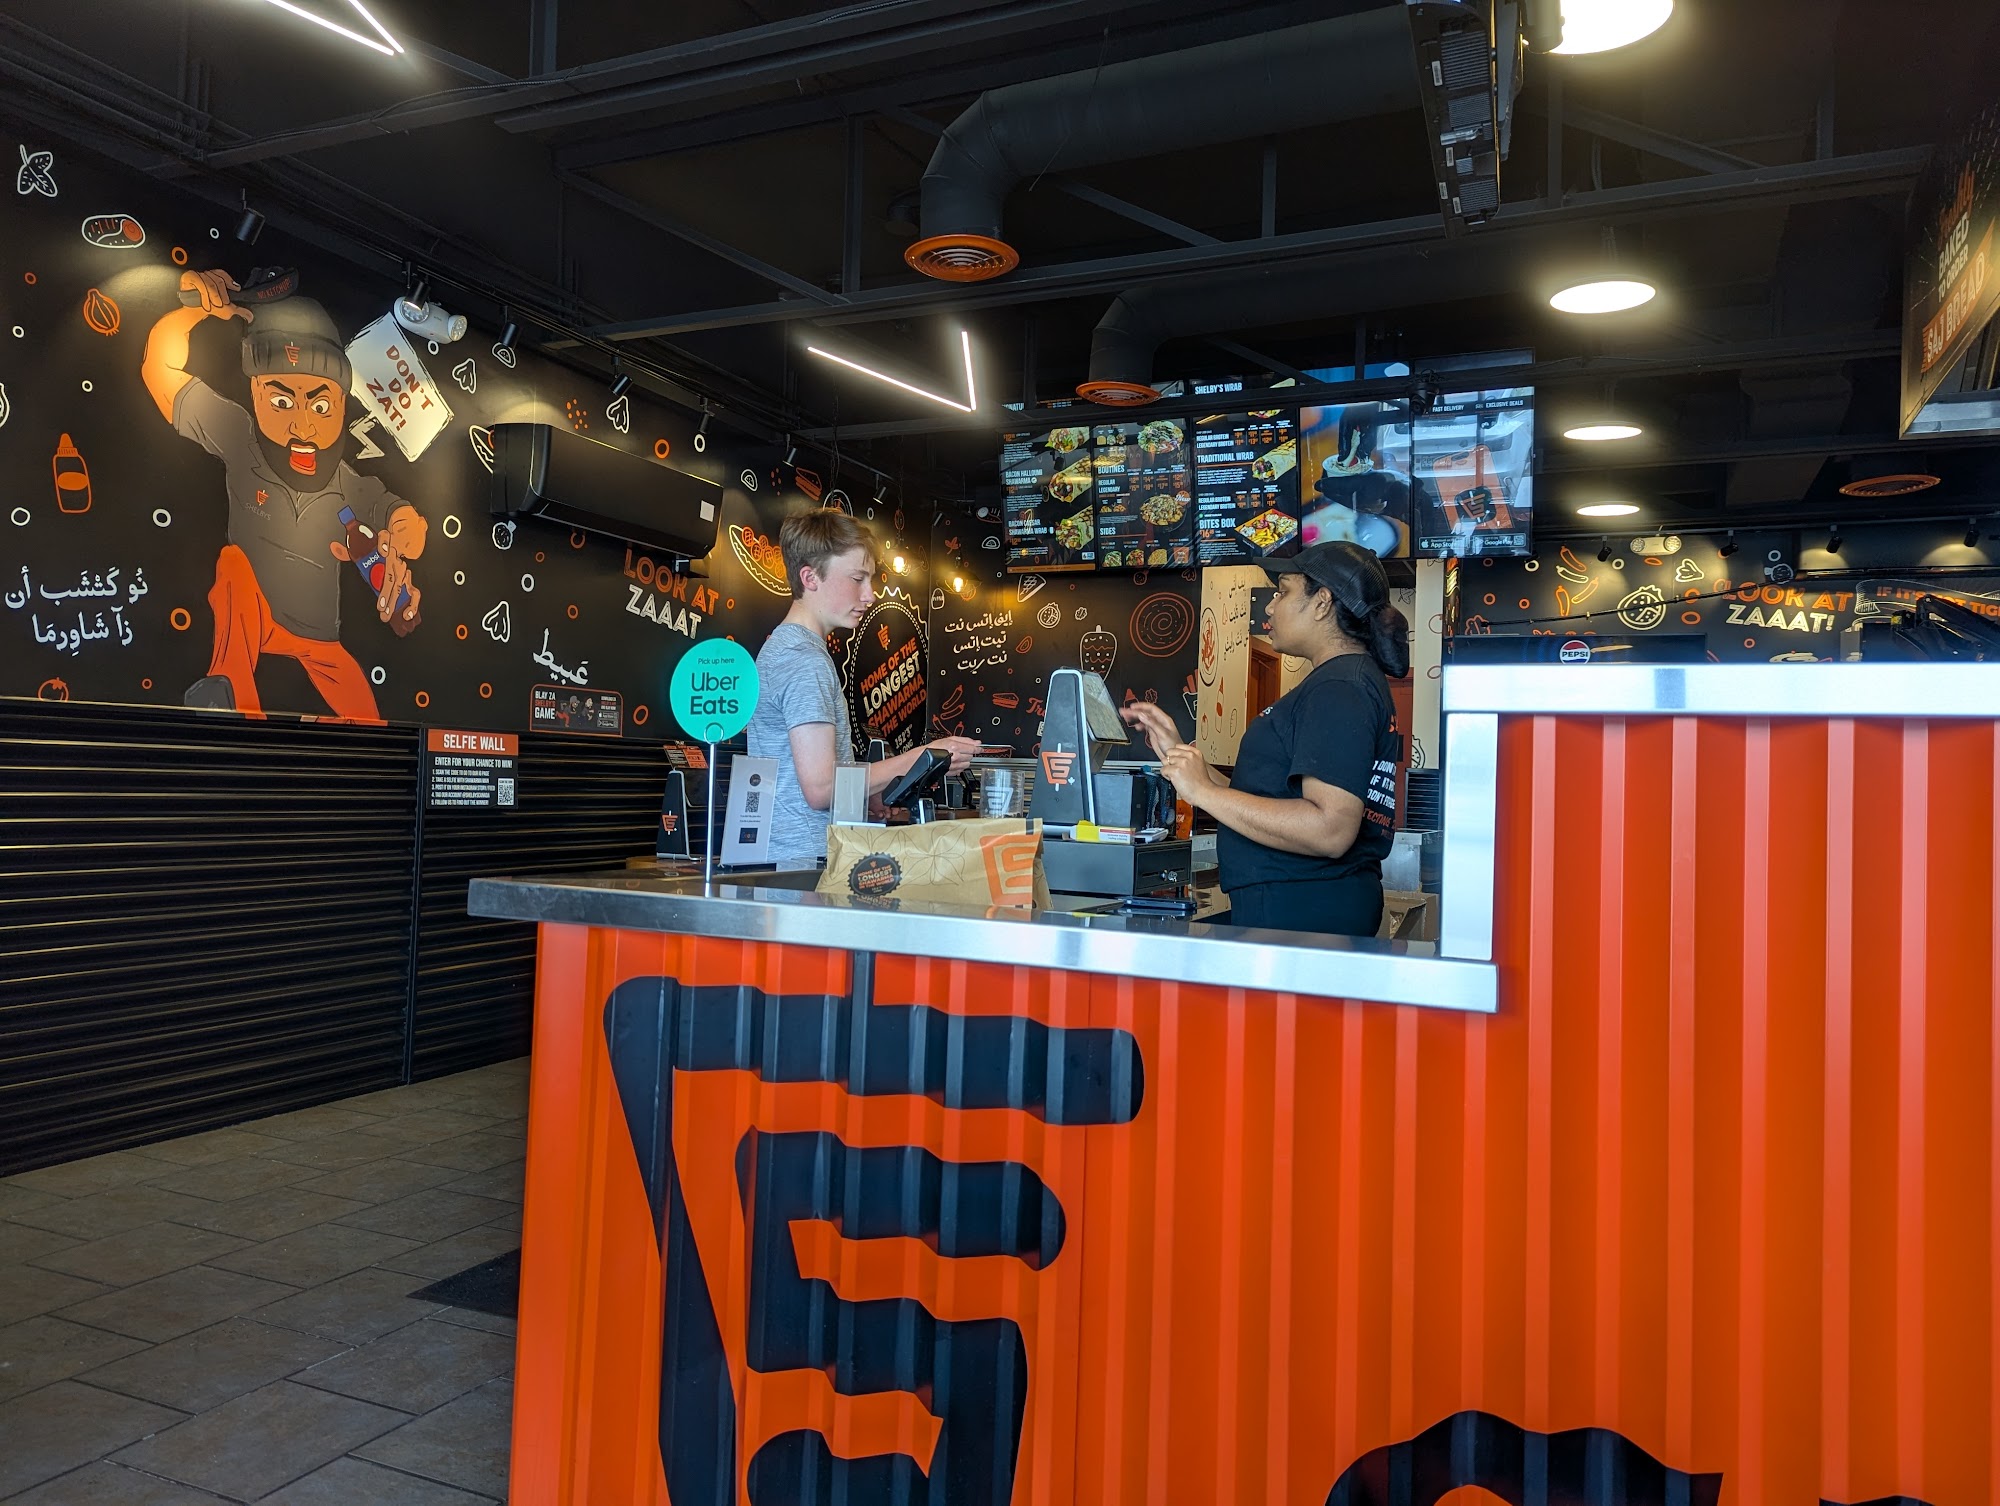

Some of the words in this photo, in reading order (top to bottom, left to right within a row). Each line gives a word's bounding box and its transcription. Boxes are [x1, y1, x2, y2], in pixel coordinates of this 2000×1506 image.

[1938, 211, 1969, 281] BAKED
[1946, 244, 1968, 289] ORDER
[1927, 313, 1945, 363] SAJ
[1946, 251, 1985, 341] BREAD
[386, 345, 434, 410] DON'T
[1195, 384, 1223, 395] SHELBY'S
[1224, 382, 1242, 392] WRAB
[366, 378, 407, 431] ZAT!
[388, 378, 411, 409] DO
[1444, 404, 1464, 412] DELIVERY
[1197, 452, 1235, 463] TRADITIONAL
[1236, 451, 1254, 460] WRAB
[1100, 527, 1116, 535] SIDES
[1200, 518, 1220, 529] BITES
[1221, 518, 1236, 528] BOX
[624, 545, 688, 603] LOOK
[691, 584, 719, 615] AT
[1722, 579, 1806, 607] LOOK
[1812, 591, 1854, 612] AT
[1876, 586, 1893, 597] IF
[626, 584, 702, 640] ZAAAT
[1726, 603, 1835, 634] ZAAAT!
[697, 657, 710, 665] Pick
[860, 662, 888, 695] HOME
[888, 651, 900, 670] OF
[900, 637, 917, 659] THE
[691, 672, 740, 692] Uber
[863, 650, 920, 717] LONGEST
[534, 707, 556, 719] GAME
[690, 696, 739, 715] Eats
[867, 673, 925, 728] SHAWARMA
[898, 688, 927, 720] WORLD
[443, 733, 477, 750] SELFIE
[480, 736, 505, 751] WALL
[435, 757, 451, 766] ENTER
[452, 757, 462, 767] FOR
[462, 758, 475, 767] YOUR
[475, 758, 494, 768] CHANCE
[495, 759, 501, 768] TO
